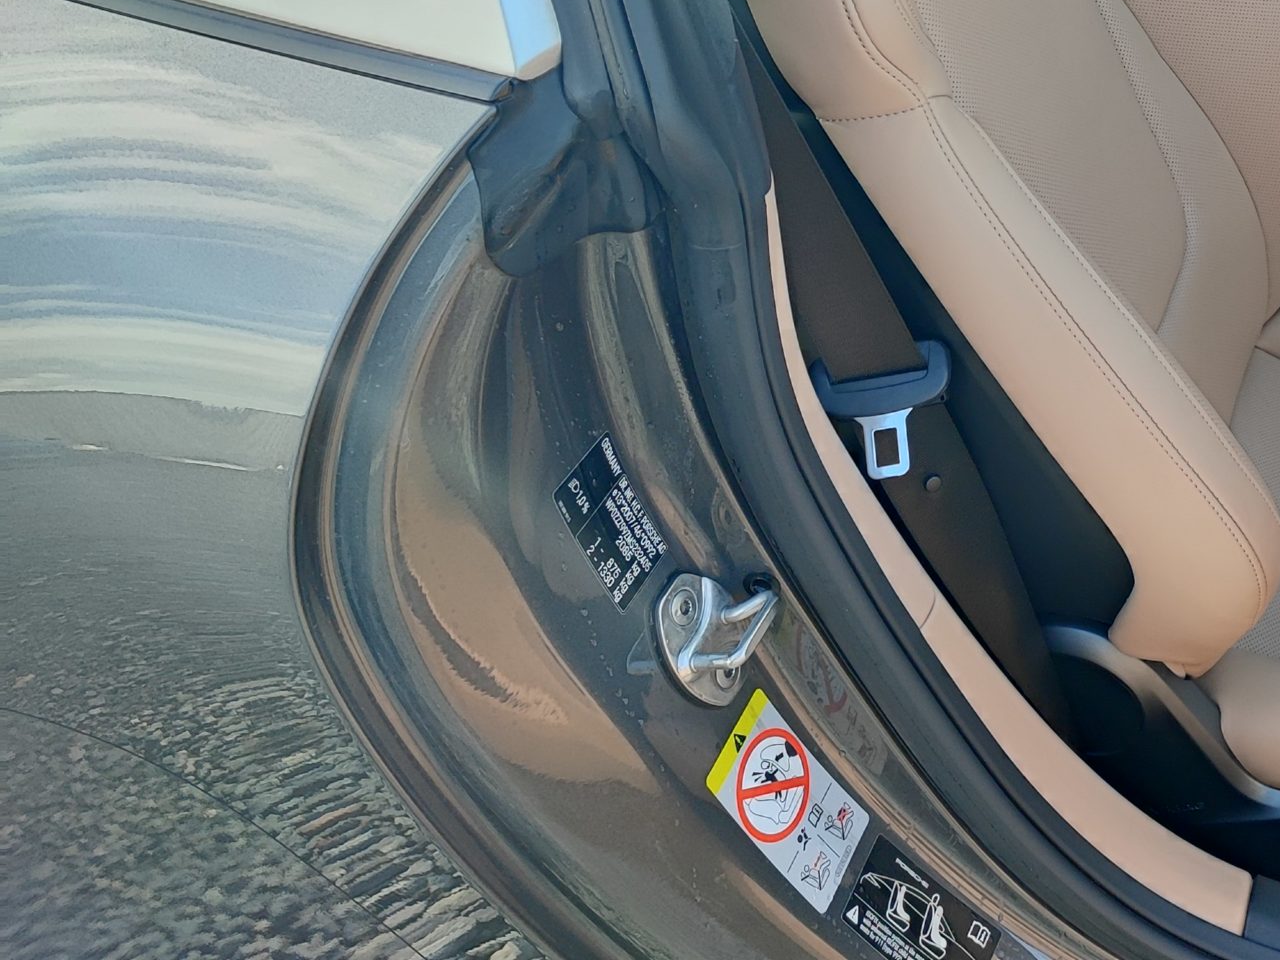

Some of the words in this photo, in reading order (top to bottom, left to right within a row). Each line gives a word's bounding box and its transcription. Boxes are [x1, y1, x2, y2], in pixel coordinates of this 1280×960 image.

[601, 437, 622, 477] GERMANY
[581, 501, 590, 515] %
[640, 515, 662, 547] PORSCHE
[656, 542, 667, 555] AG
[586, 545, 595, 556] 2
[598, 561, 615, 588] 1330
[612, 586, 623, 603] kg
[594, 537, 602, 547] 1
[606, 557, 622, 579] 875
[619, 577, 629, 594] kg
[615, 535, 634, 561] 2085
[632, 560, 641, 577] kg
[625, 569, 635, 586] kg
